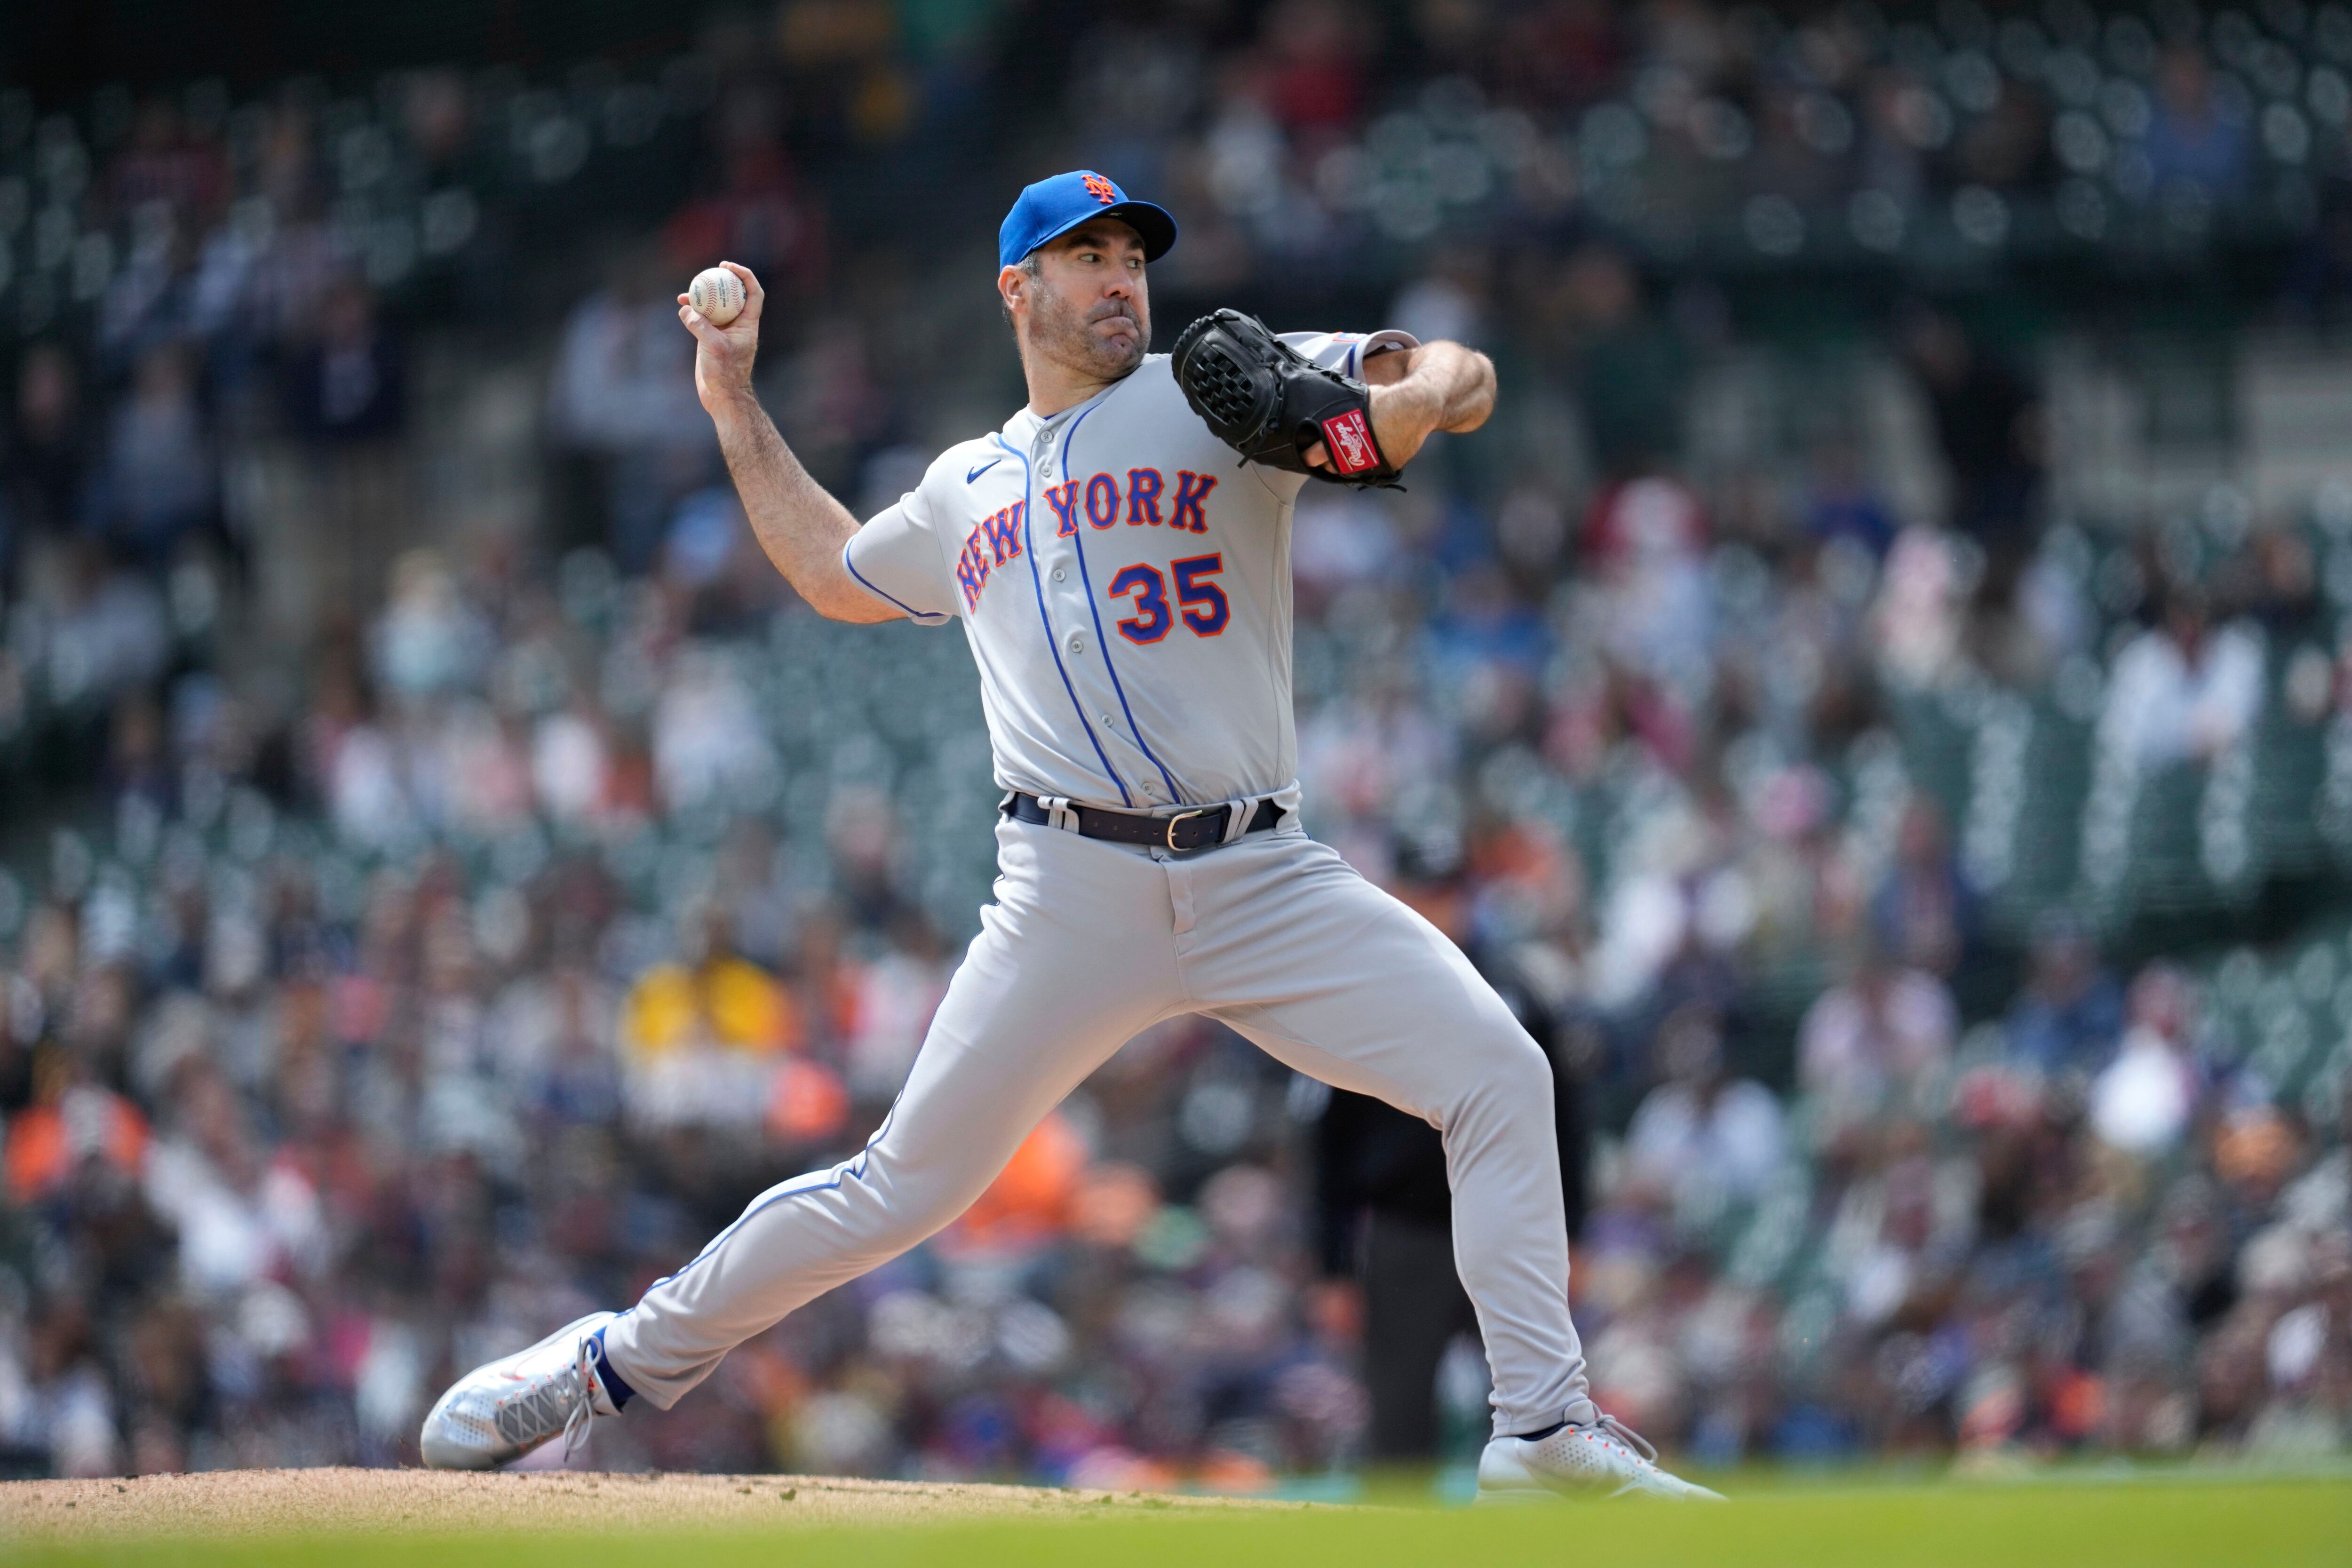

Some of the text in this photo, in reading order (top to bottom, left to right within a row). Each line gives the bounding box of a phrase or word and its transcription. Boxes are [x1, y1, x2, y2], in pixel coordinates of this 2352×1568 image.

[1336, 422, 1365, 466] Rawlings
[957, 467, 1218, 614] NEW YORK
[1108, 553, 1231, 646] 35
